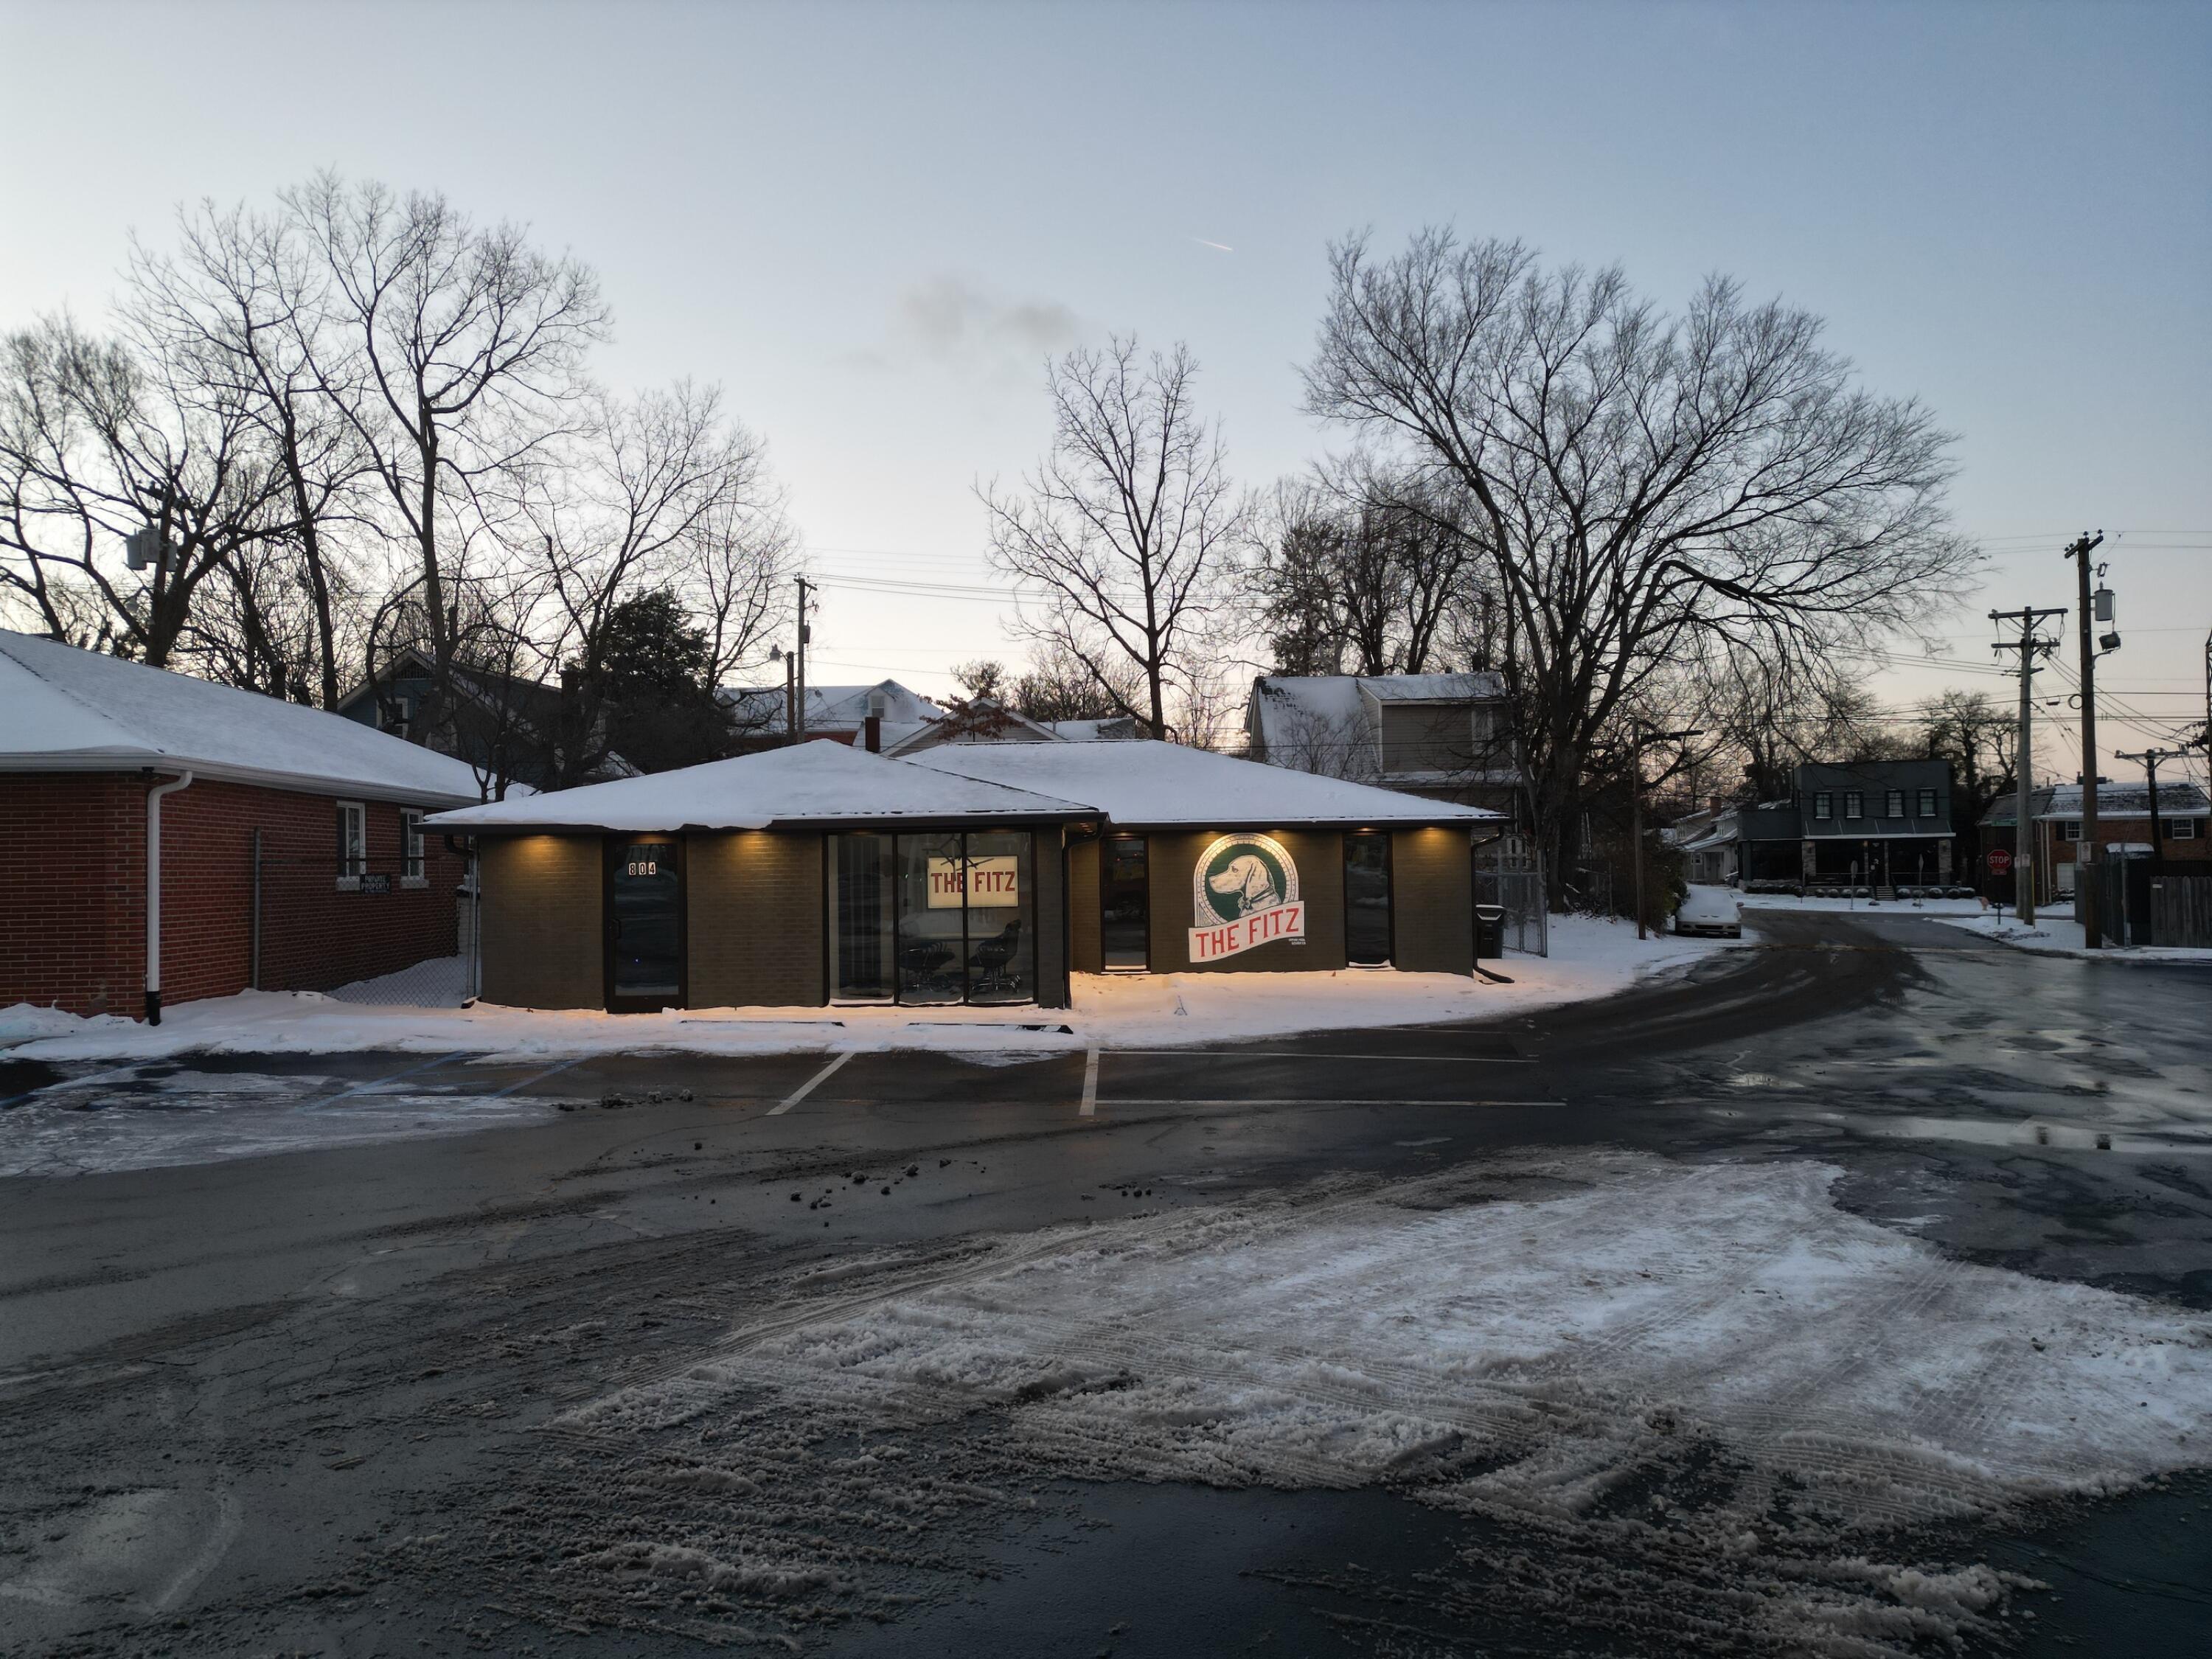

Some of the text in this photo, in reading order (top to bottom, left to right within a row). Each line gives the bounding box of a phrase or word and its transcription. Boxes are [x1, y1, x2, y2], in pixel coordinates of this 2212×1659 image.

[1989, 855, 2010, 864] STOP
[630, 863, 655, 874] 804
[361, 882, 390, 890] PROPERTY
[931, 871, 1015, 893] THE FITZ
[1195, 908, 1299, 957] THE FITZ
